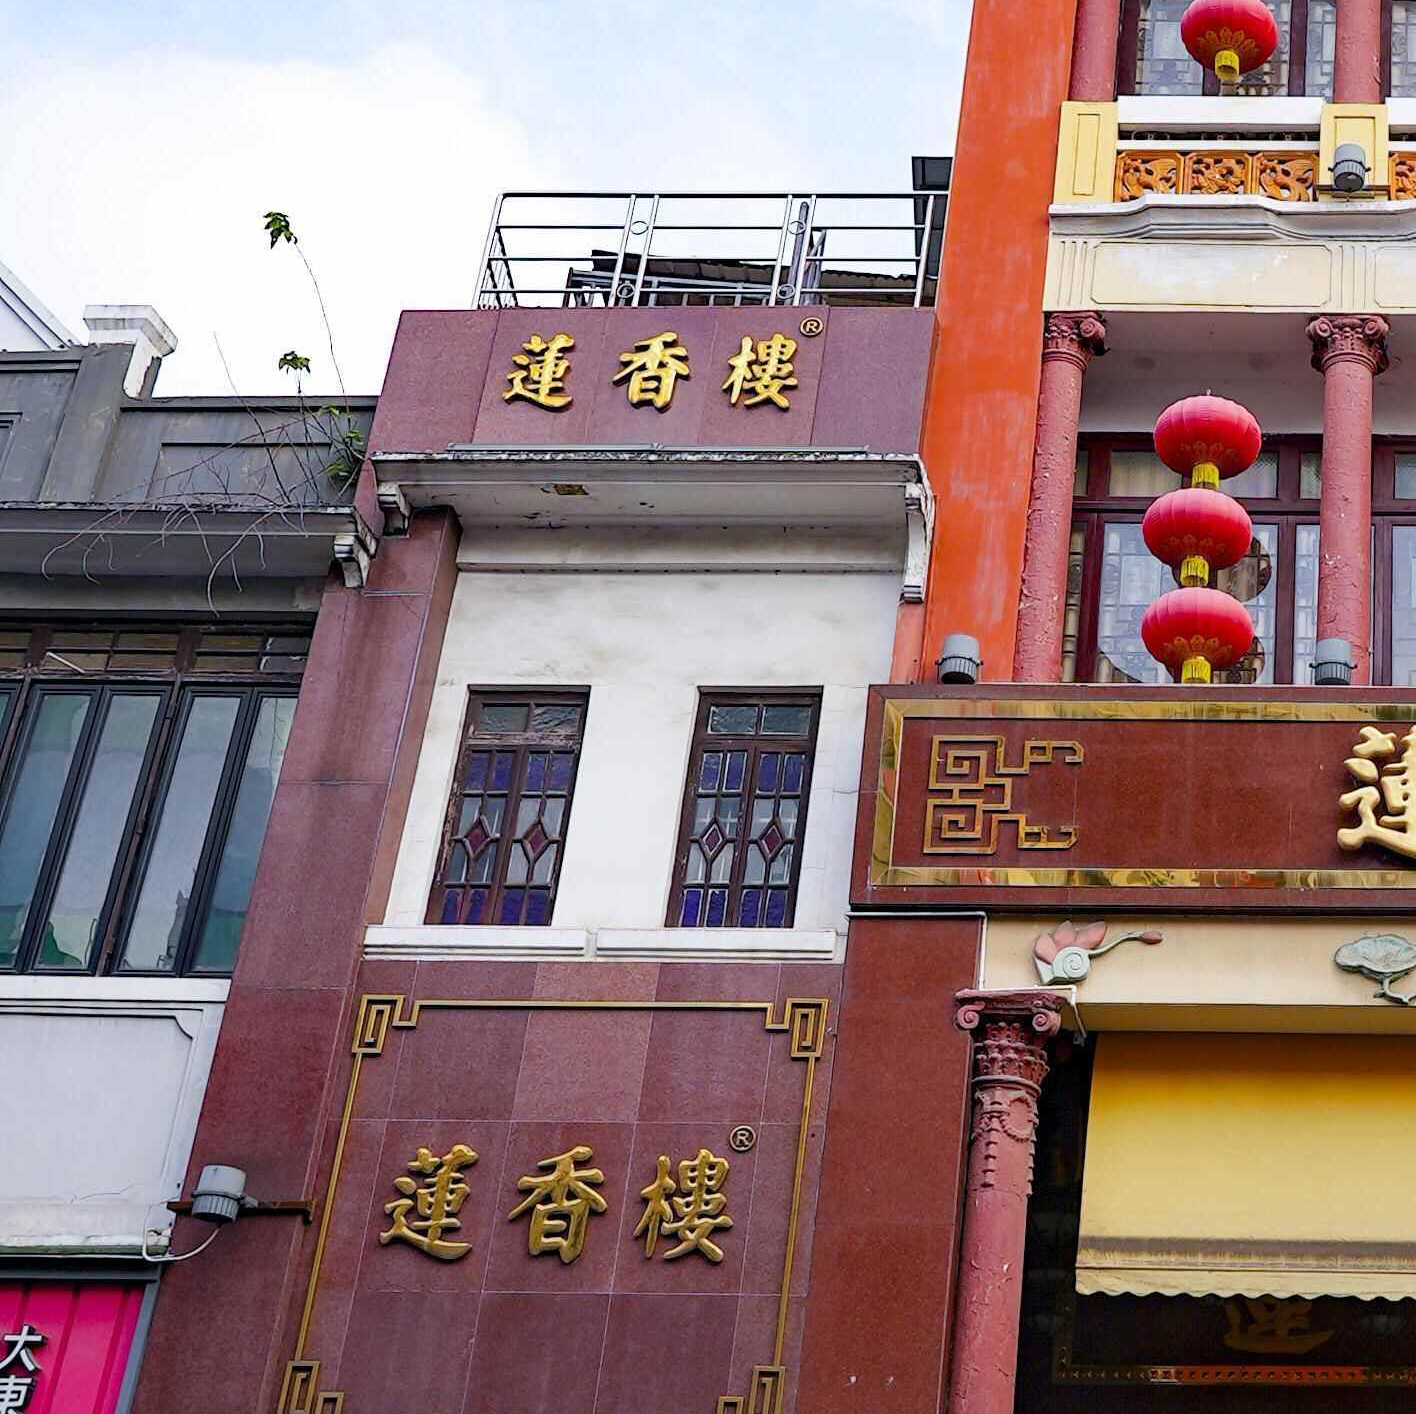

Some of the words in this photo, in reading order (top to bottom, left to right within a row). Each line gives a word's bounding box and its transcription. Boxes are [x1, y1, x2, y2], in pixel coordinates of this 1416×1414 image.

[502, 330, 799, 413] 蓮香樓
[377, 1142, 735, 1266] 蓮香樓
